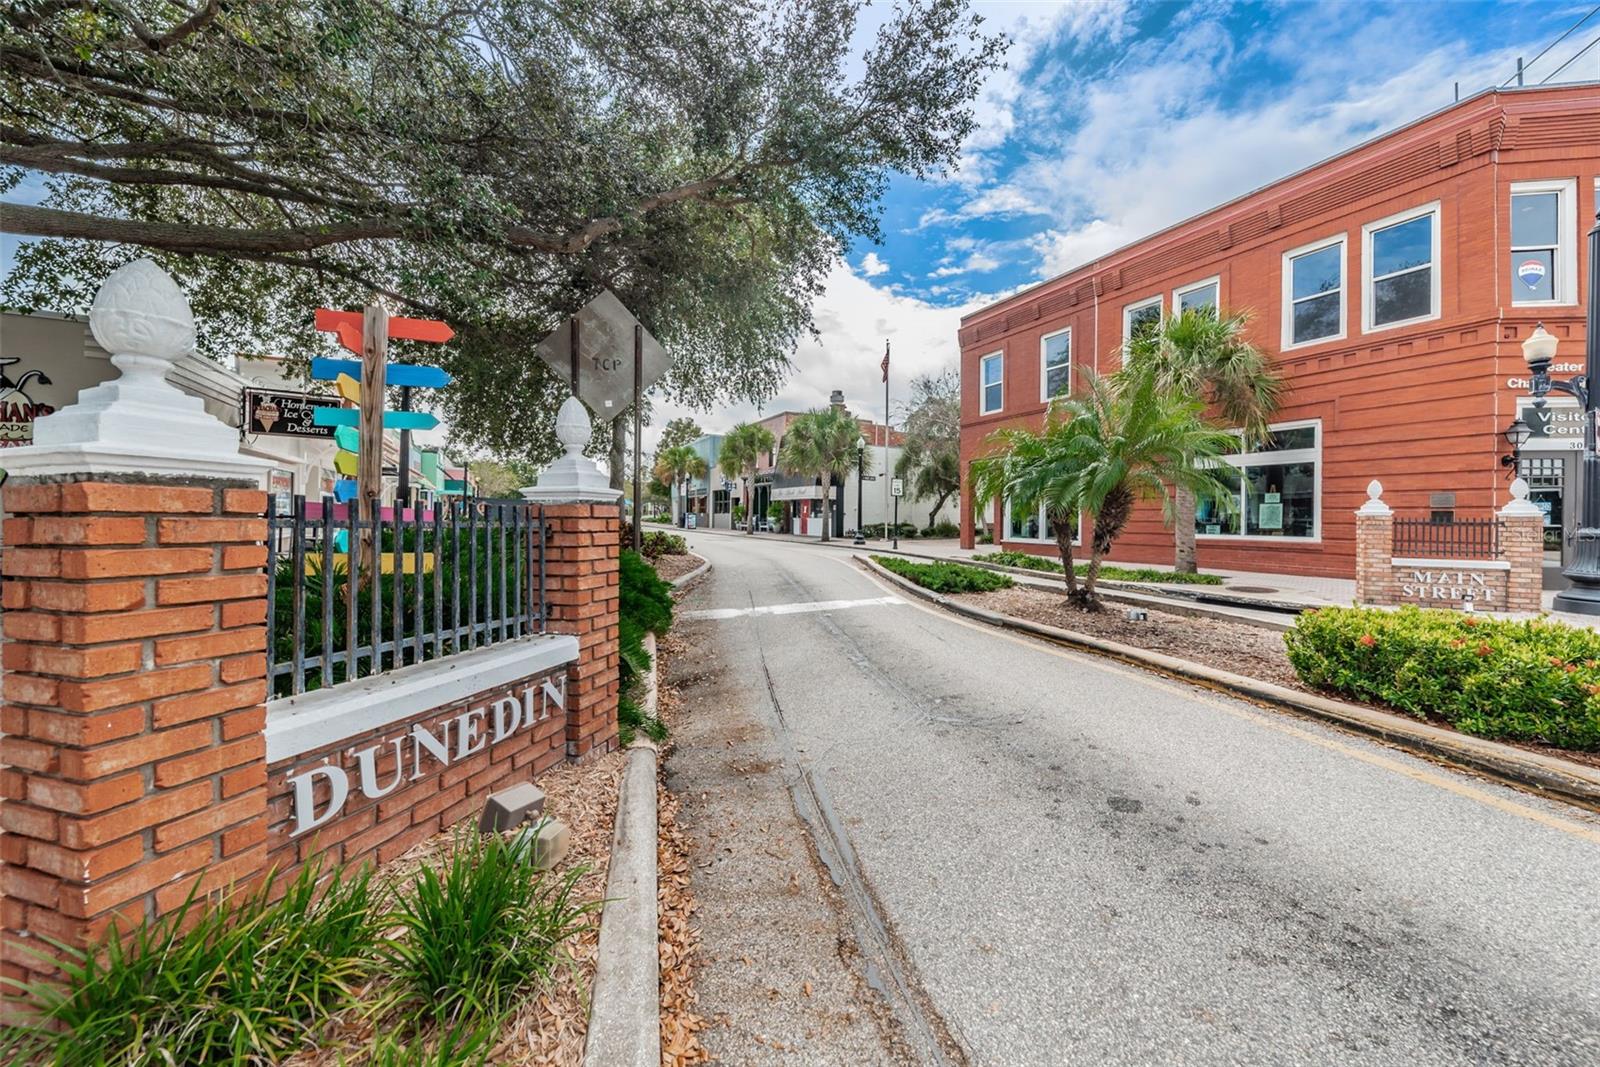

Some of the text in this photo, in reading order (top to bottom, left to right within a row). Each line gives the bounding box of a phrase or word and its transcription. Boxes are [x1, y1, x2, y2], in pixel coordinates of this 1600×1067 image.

[591, 357, 622, 371] TCP
[283, 408, 299, 418] Ice
[287, 422, 329, 435] Desserts
[302, 418, 313, 428] &
[1412, 570, 1486, 586] MAIN
[1402, 584, 1496, 601] STREET
[287, 675, 568, 838] DUNEDIN
